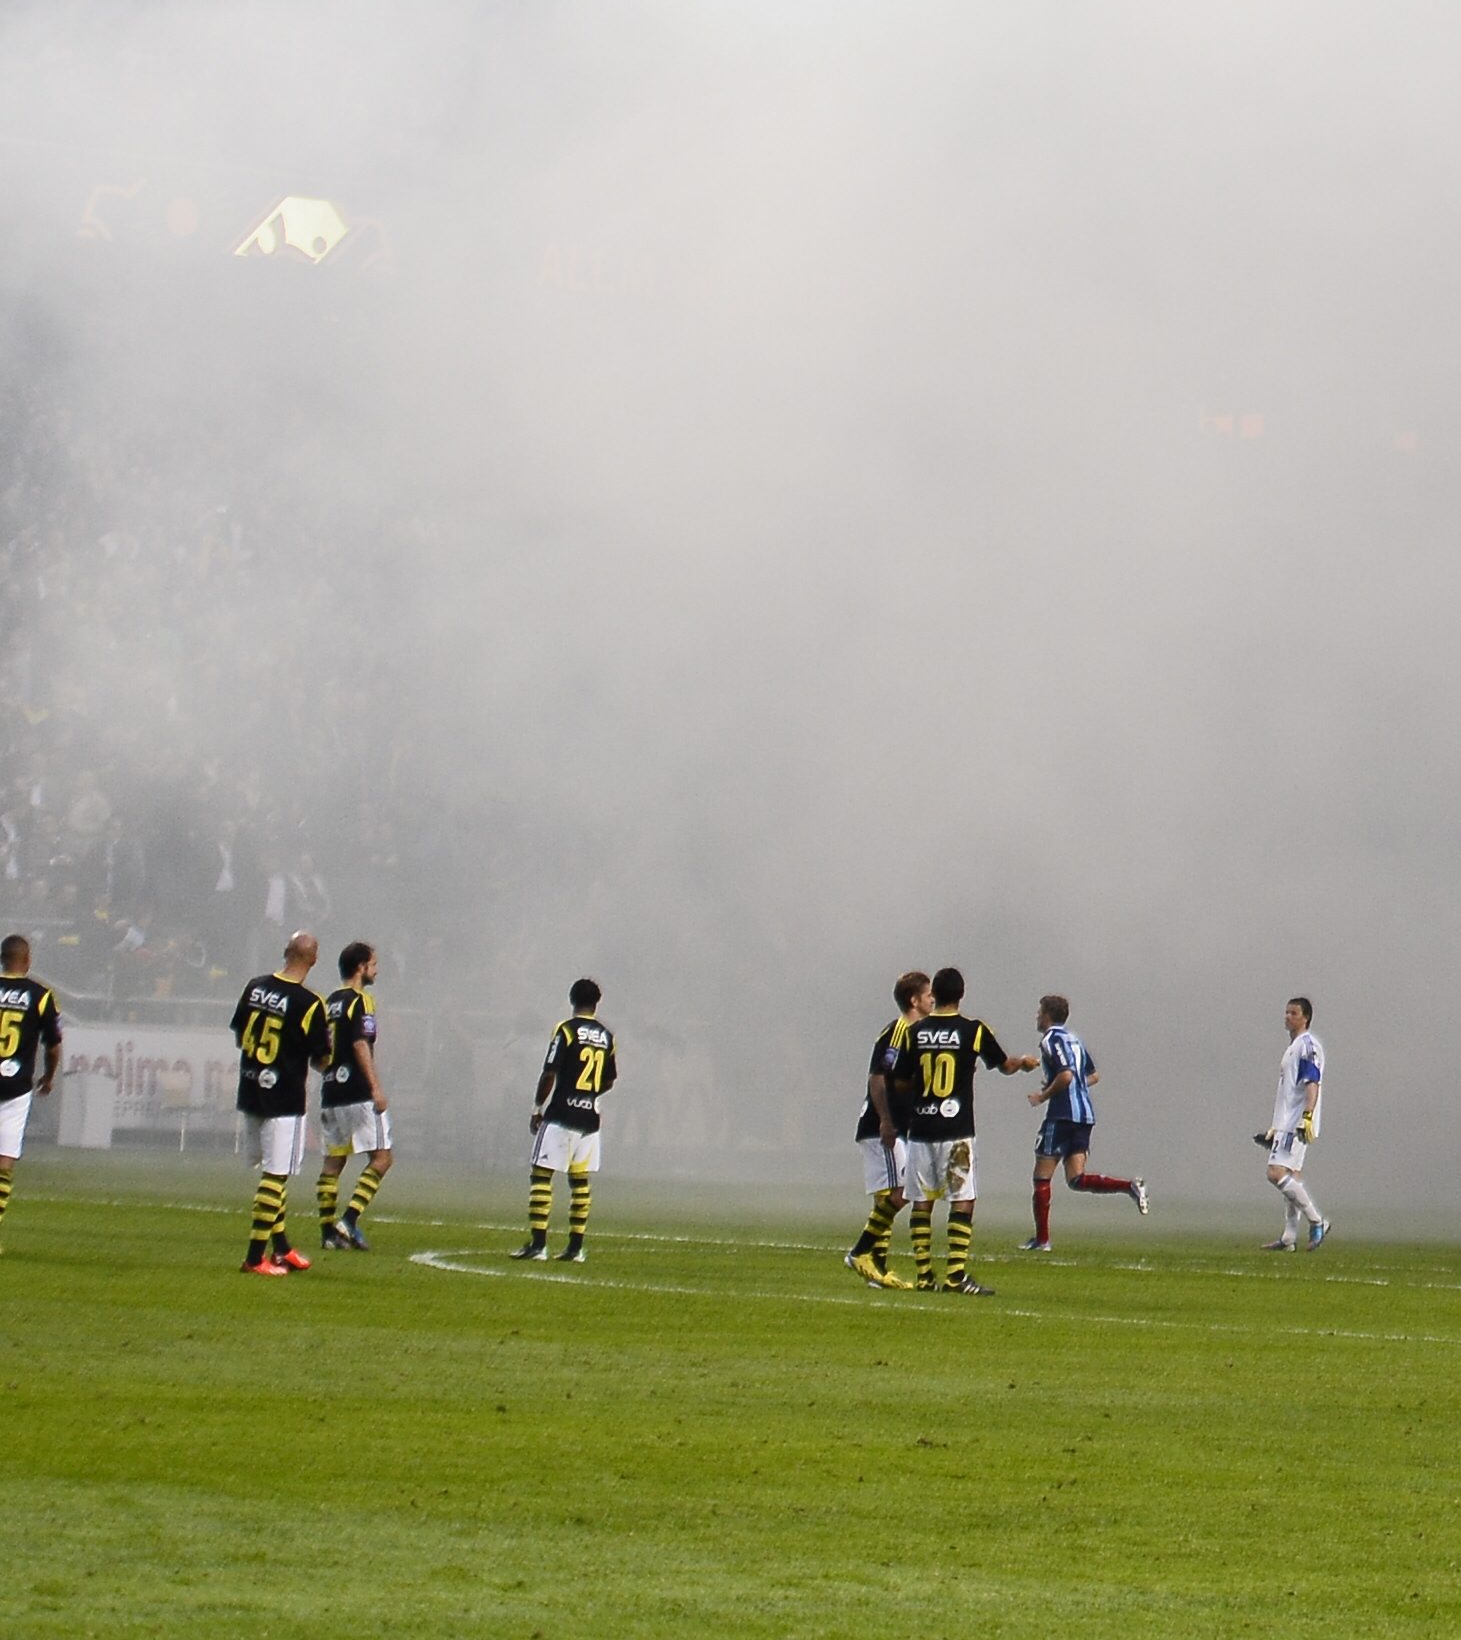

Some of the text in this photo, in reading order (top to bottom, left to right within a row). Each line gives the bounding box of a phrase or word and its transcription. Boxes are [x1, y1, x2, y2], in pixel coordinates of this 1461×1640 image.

[0, 988, 29, 1006] VEA
[250, 988, 288, 1012] SVEA
[0, 1010, 24, 1058] 5
[242, 1010, 282, 1065] 45
[577, 1027, 608, 1046] SVEA
[917, 1031, 961, 1045] SVEA
[576, 1046, 604, 1093] 21
[920, 1052, 956, 1098] 10
